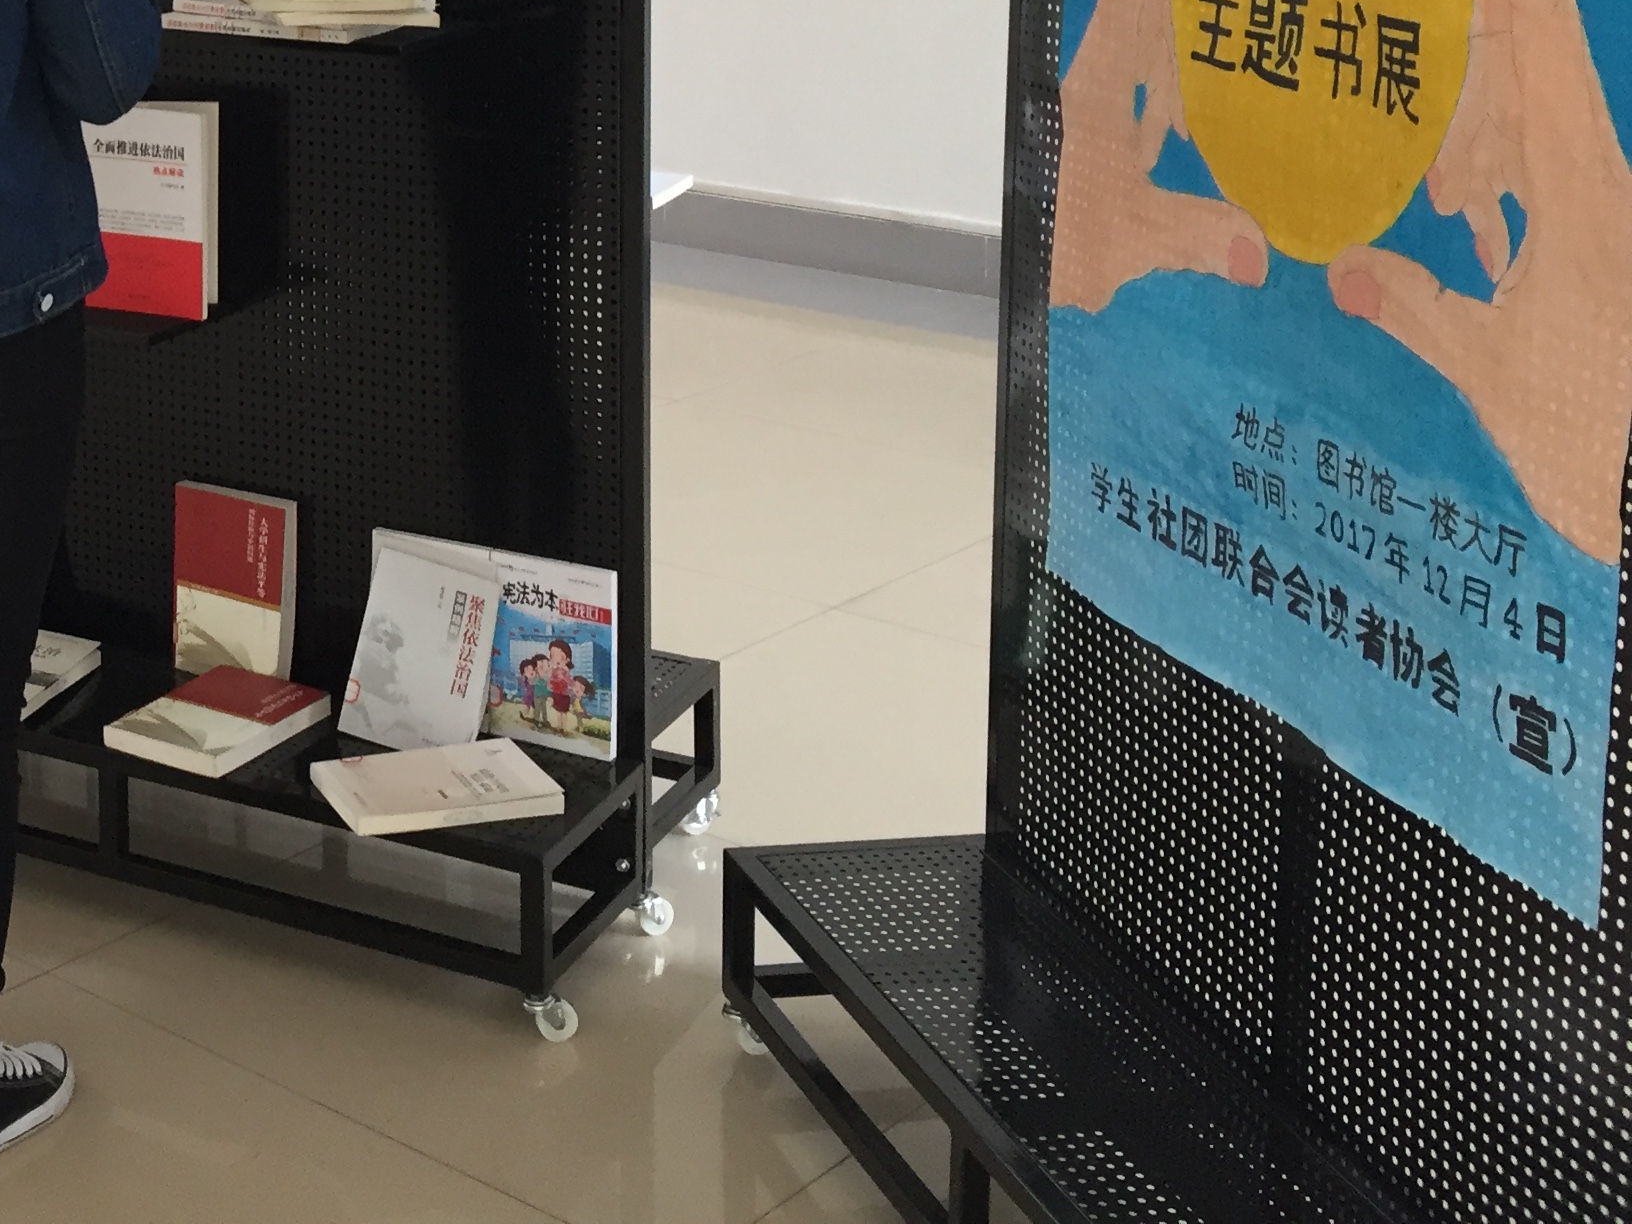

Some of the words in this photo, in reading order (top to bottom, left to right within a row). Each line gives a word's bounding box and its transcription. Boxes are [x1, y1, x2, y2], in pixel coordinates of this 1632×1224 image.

[93, 138, 185, 162] 全面推进依法治国
[502, 581, 559, 613] 宪法为本
[449, 595, 486, 699] 聚焦依法治国
